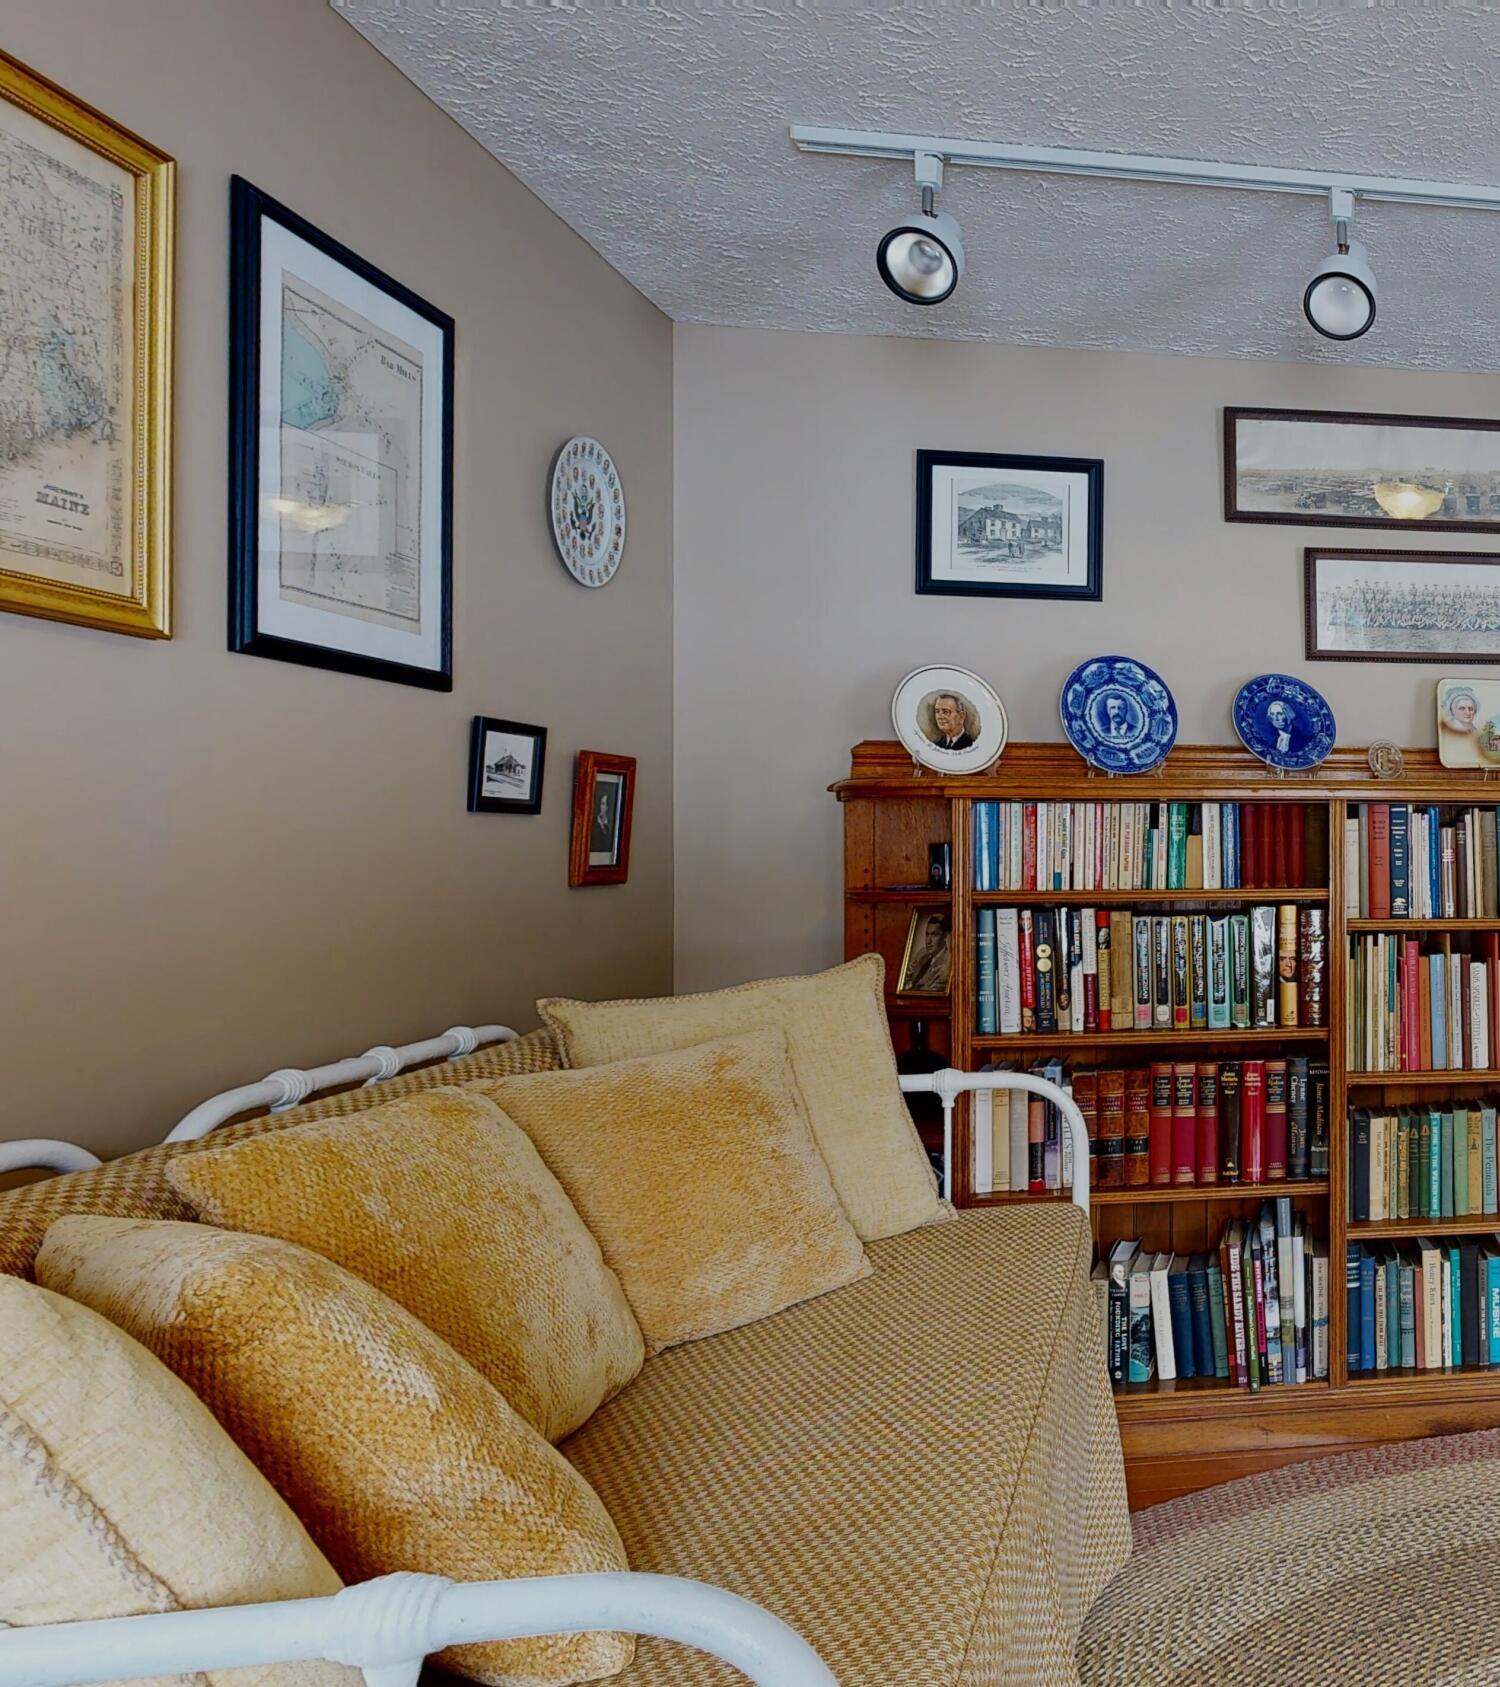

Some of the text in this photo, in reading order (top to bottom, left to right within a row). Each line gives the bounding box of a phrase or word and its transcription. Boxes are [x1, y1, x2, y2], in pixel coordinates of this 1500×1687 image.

[35, 491, 90, 516] MAINE
[1408, 948, 1417, 994] PORTLAND
[1289, 1075, 1298, 1104] Cheney
[1298, 1078, 1307, 1102] Lynne
[1315, 1082, 1325, 1136] James Madison
[1484, 1136, 1495, 1196] The Peninsula
[1229, 1247, 1246, 1352] RIDE THE SANDY RIVER
[1428, 1263, 1437, 1306] Henry Knox
[1491, 1287, 1500, 1339] MUSKIE
[1114, 1340, 1122, 1367] FATHER
